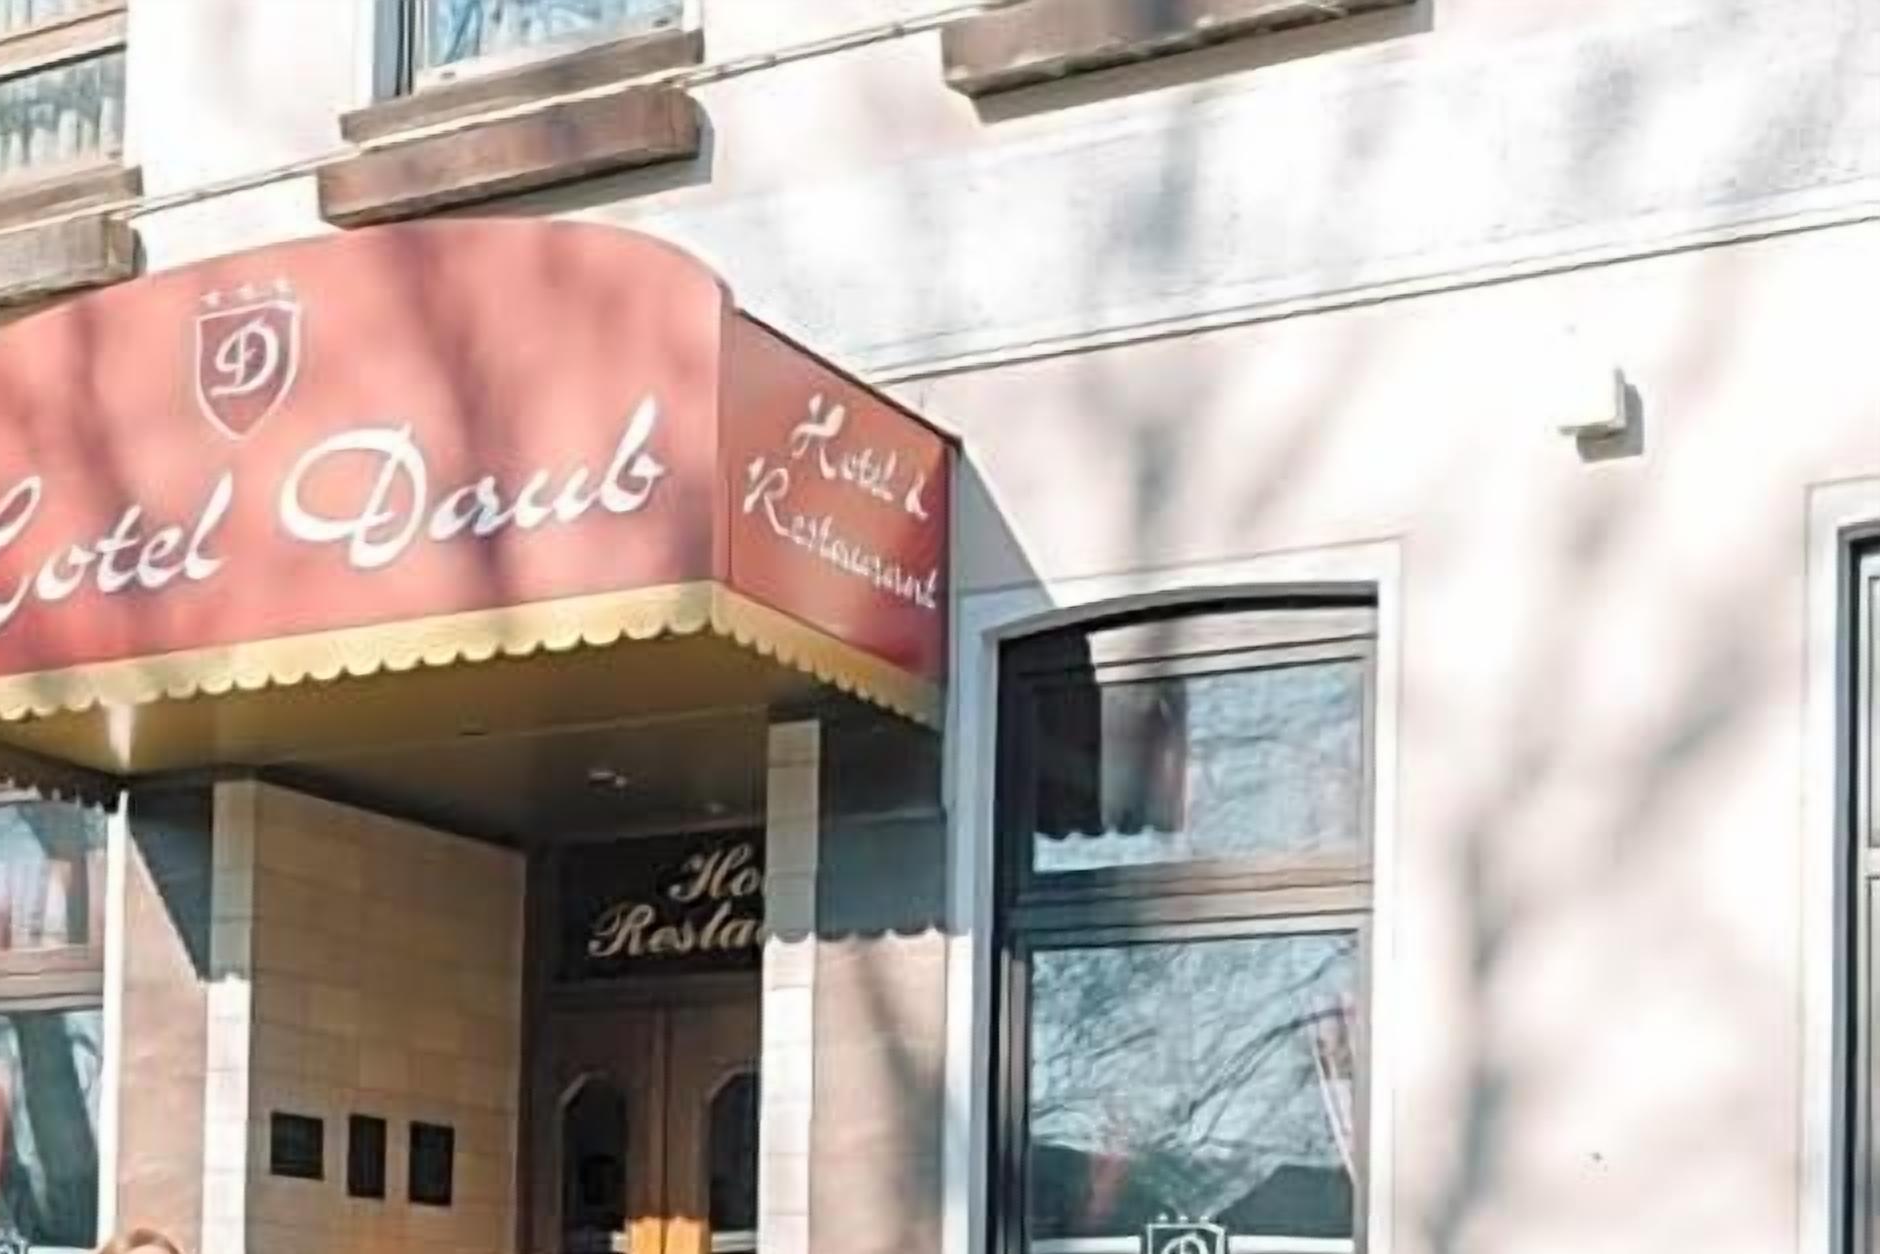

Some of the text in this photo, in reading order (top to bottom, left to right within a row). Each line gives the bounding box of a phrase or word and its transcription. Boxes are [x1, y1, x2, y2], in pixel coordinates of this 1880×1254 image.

[279, 394, 666, 570] Daub
[789, 393, 898, 502] Hotel
[669, 843, 767, 901] Ho
